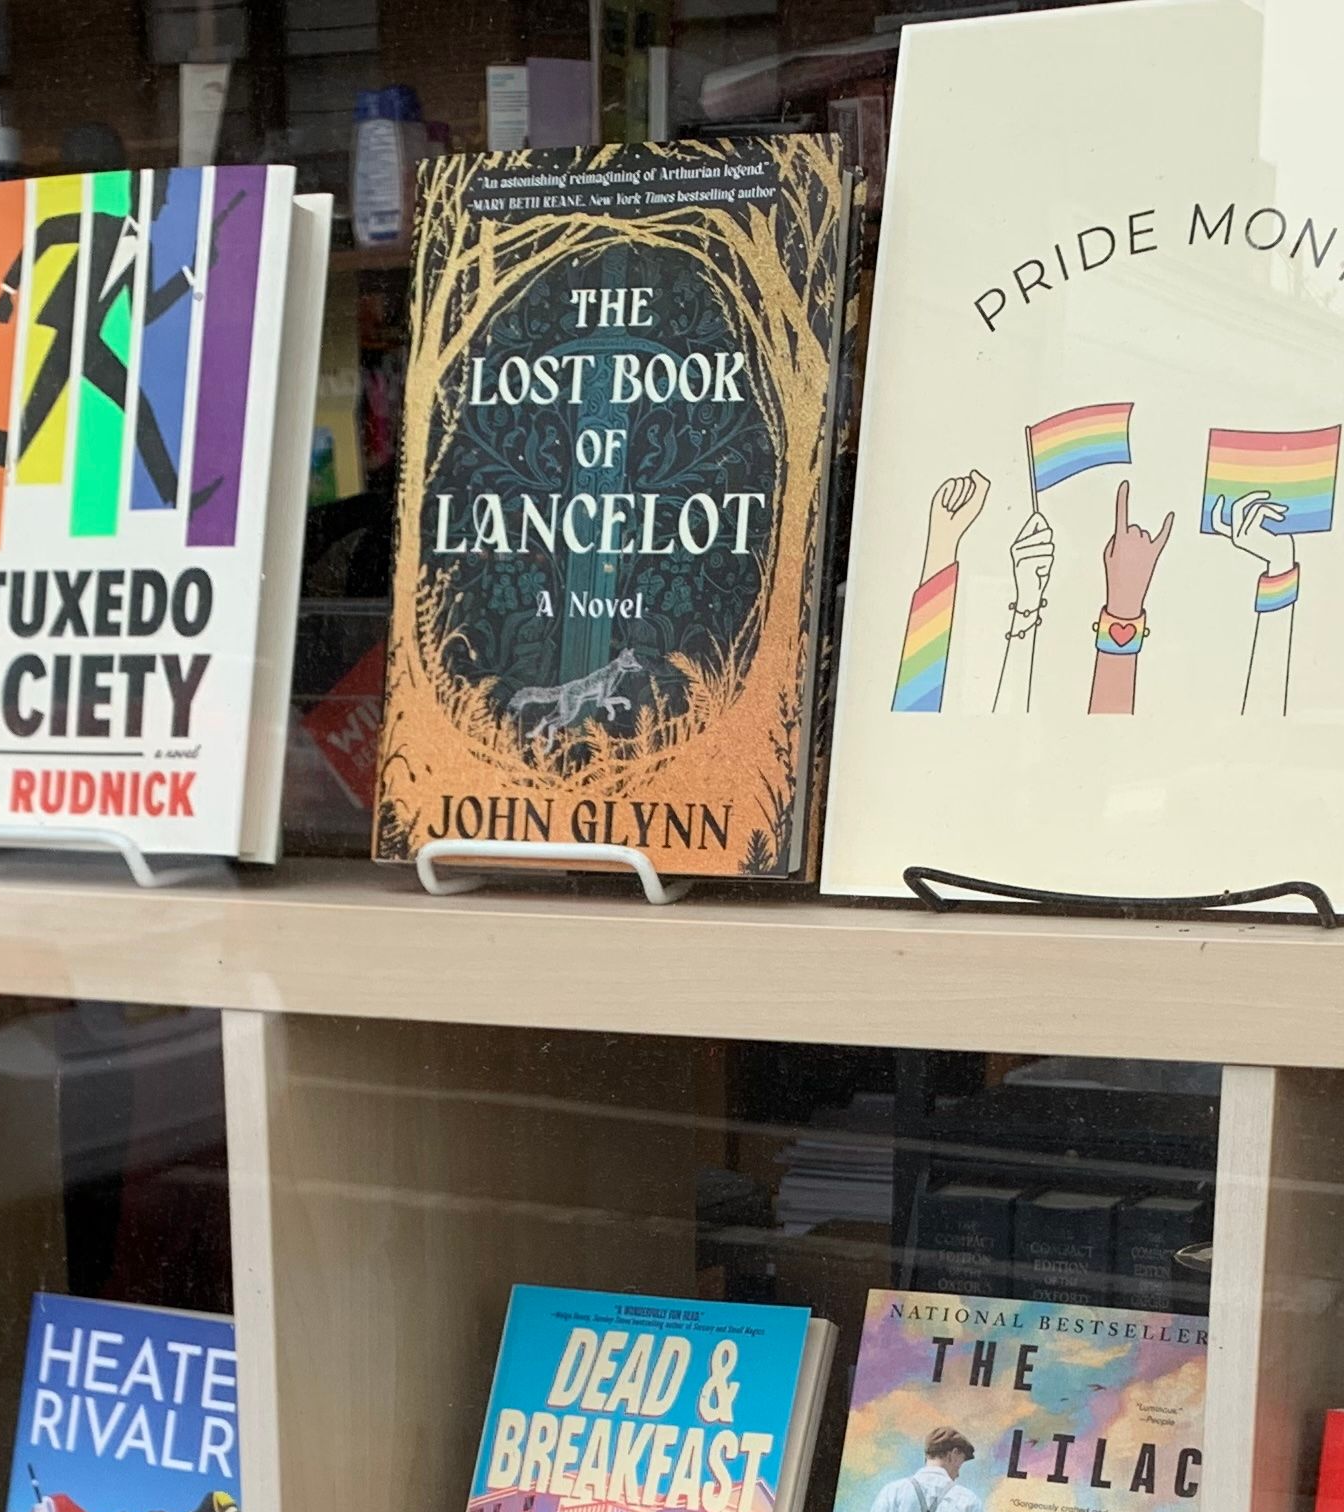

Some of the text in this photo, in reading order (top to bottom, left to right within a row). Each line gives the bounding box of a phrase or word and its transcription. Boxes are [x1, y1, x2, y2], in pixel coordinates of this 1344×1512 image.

[974, 210, 1158, 332] PRIDE
[571, 288, 653, 328] THE
[471, 350, 745, 405] LOST BOOK
[575, 428, 626, 468] OF
[434, 493, 764, 555] LANCELOT
[536, 590, 643, 619] A Novel
[10, 769, 197, 817] RUDNICK
[429, 799, 731, 850] JOHN GLYNN
[890, 1304, 1210, 1346] NATIONAL BESTSELLER
[38, 1323, 238, 1412] HEATE
[547, 1327, 740, 1424] DEAD &
[932, 1336, 1039, 1391] THE
[31, 1391, 234, 1477] RIVALR
[1007, 1429, 1202, 1498] LILAC
